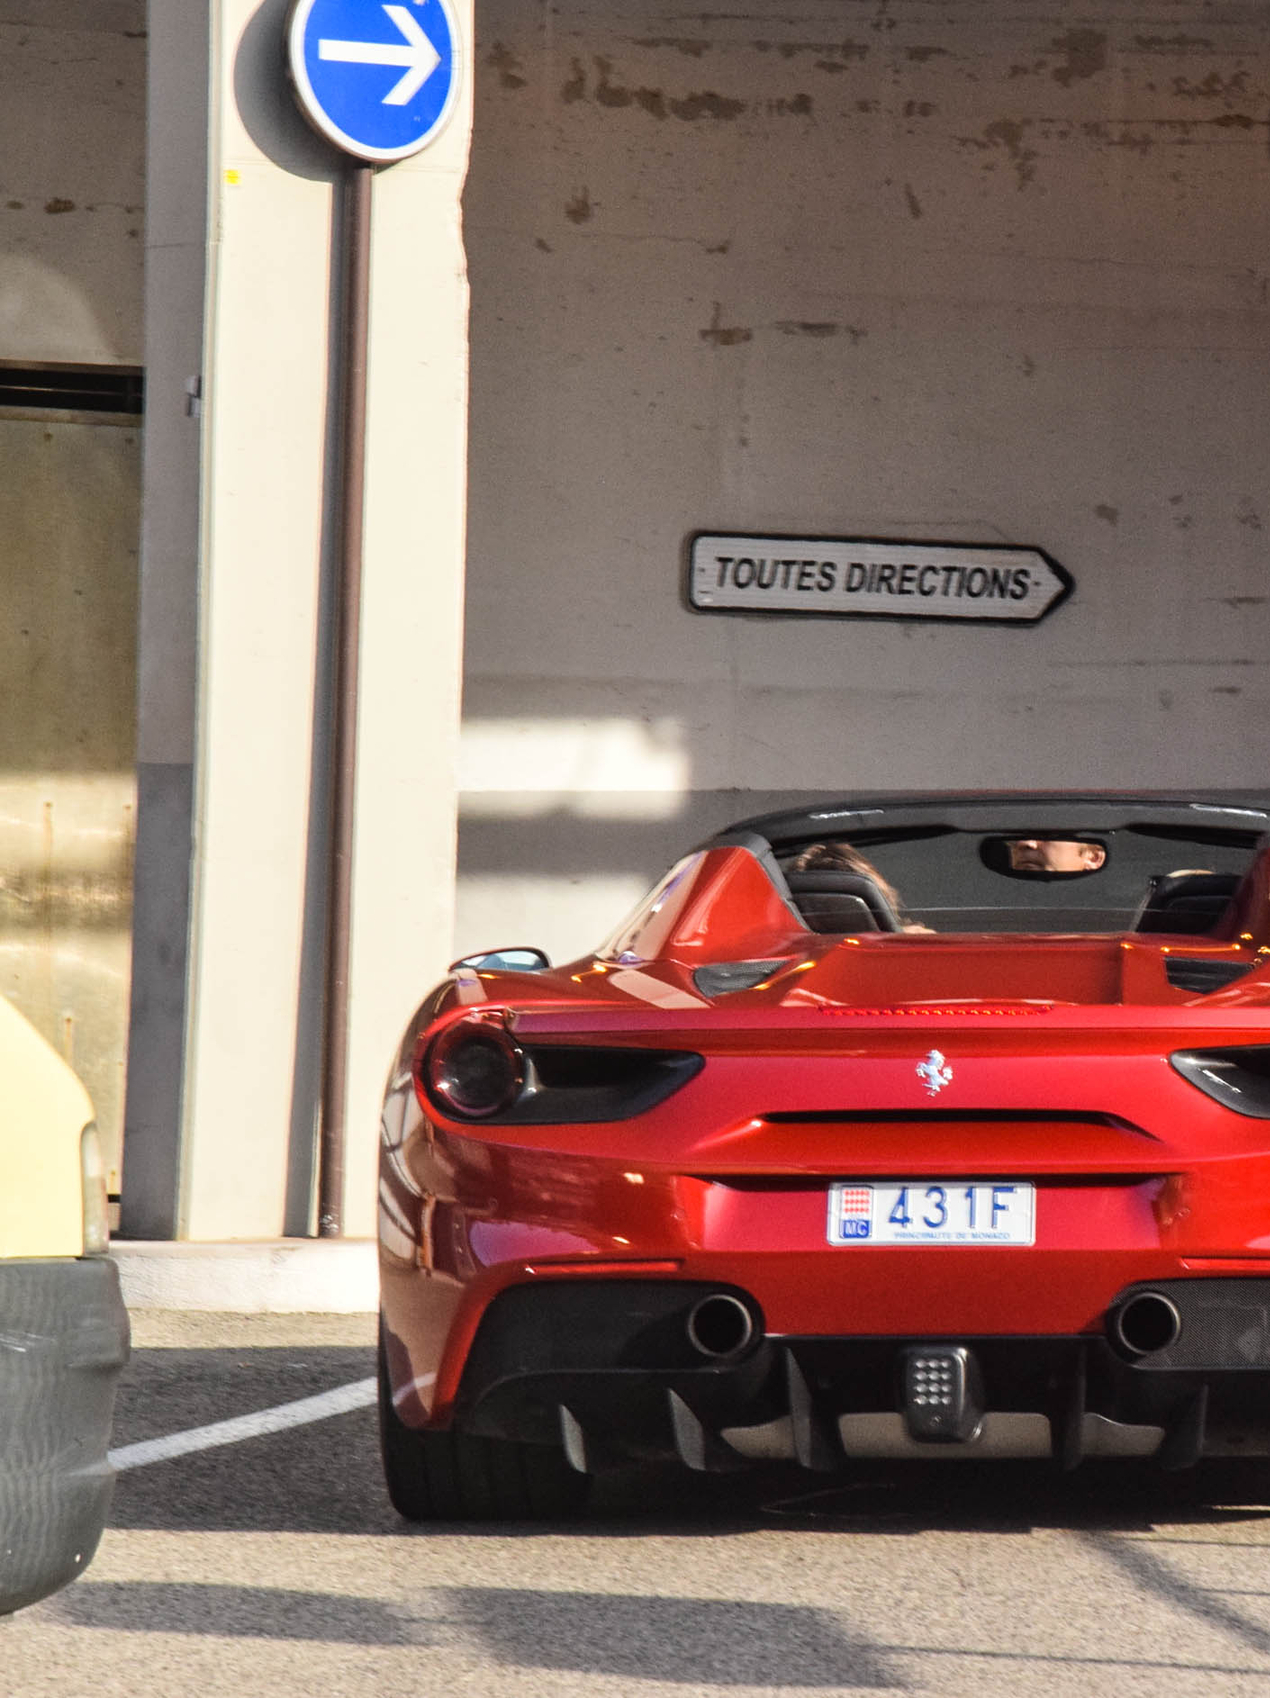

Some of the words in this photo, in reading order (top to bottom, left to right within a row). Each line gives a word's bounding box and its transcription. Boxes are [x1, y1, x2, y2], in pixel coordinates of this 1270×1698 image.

[715, 556, 837, 592] TOUTES
[844, 562, 1031, 600] DIRECTIONS
[845, 1220, 870, 1237] MC
